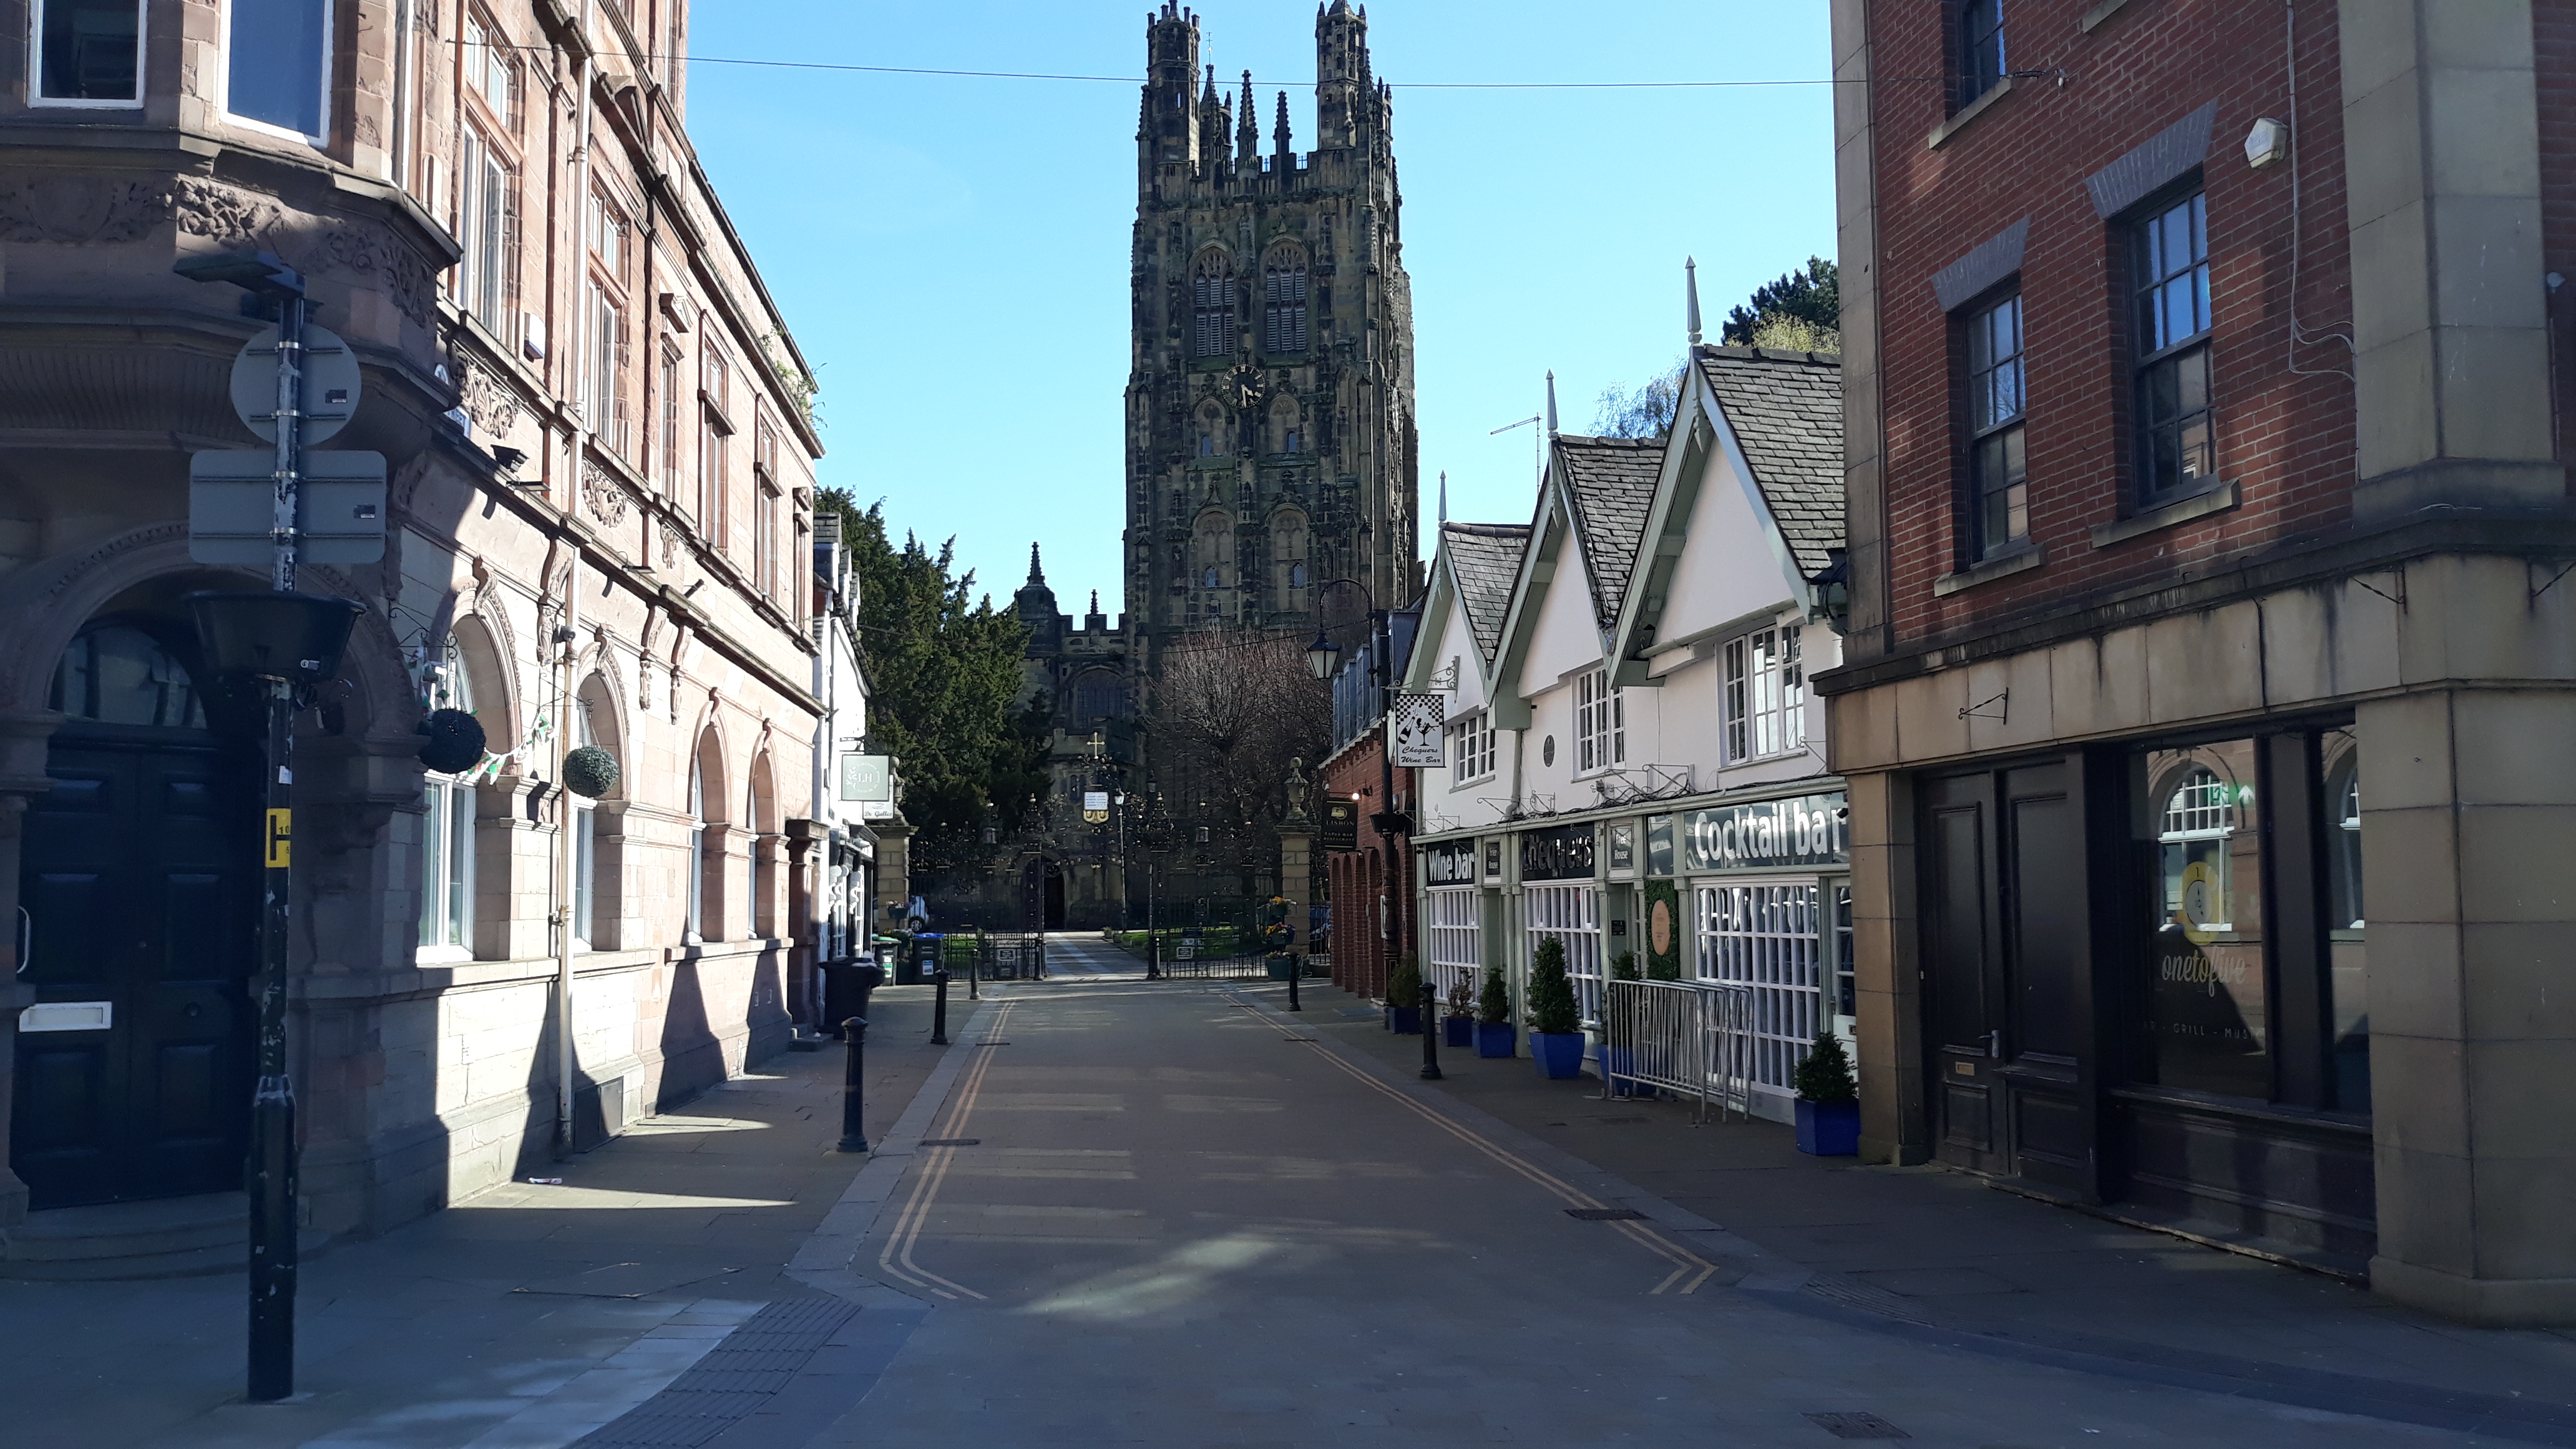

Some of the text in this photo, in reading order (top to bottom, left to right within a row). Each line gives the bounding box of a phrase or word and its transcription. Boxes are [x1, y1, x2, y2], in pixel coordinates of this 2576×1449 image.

[1616, 833, 1627, 844] Free
[1694, 801, 1847, 861] Cocktail bar
[1427, 847, 1475, 882] Wine bar
[1521, 834, 1595, 879] Chequers
[2173, 1022, 2205, 1037] GRILL
[2224, 1027, 2264, 1040] MUSIC
